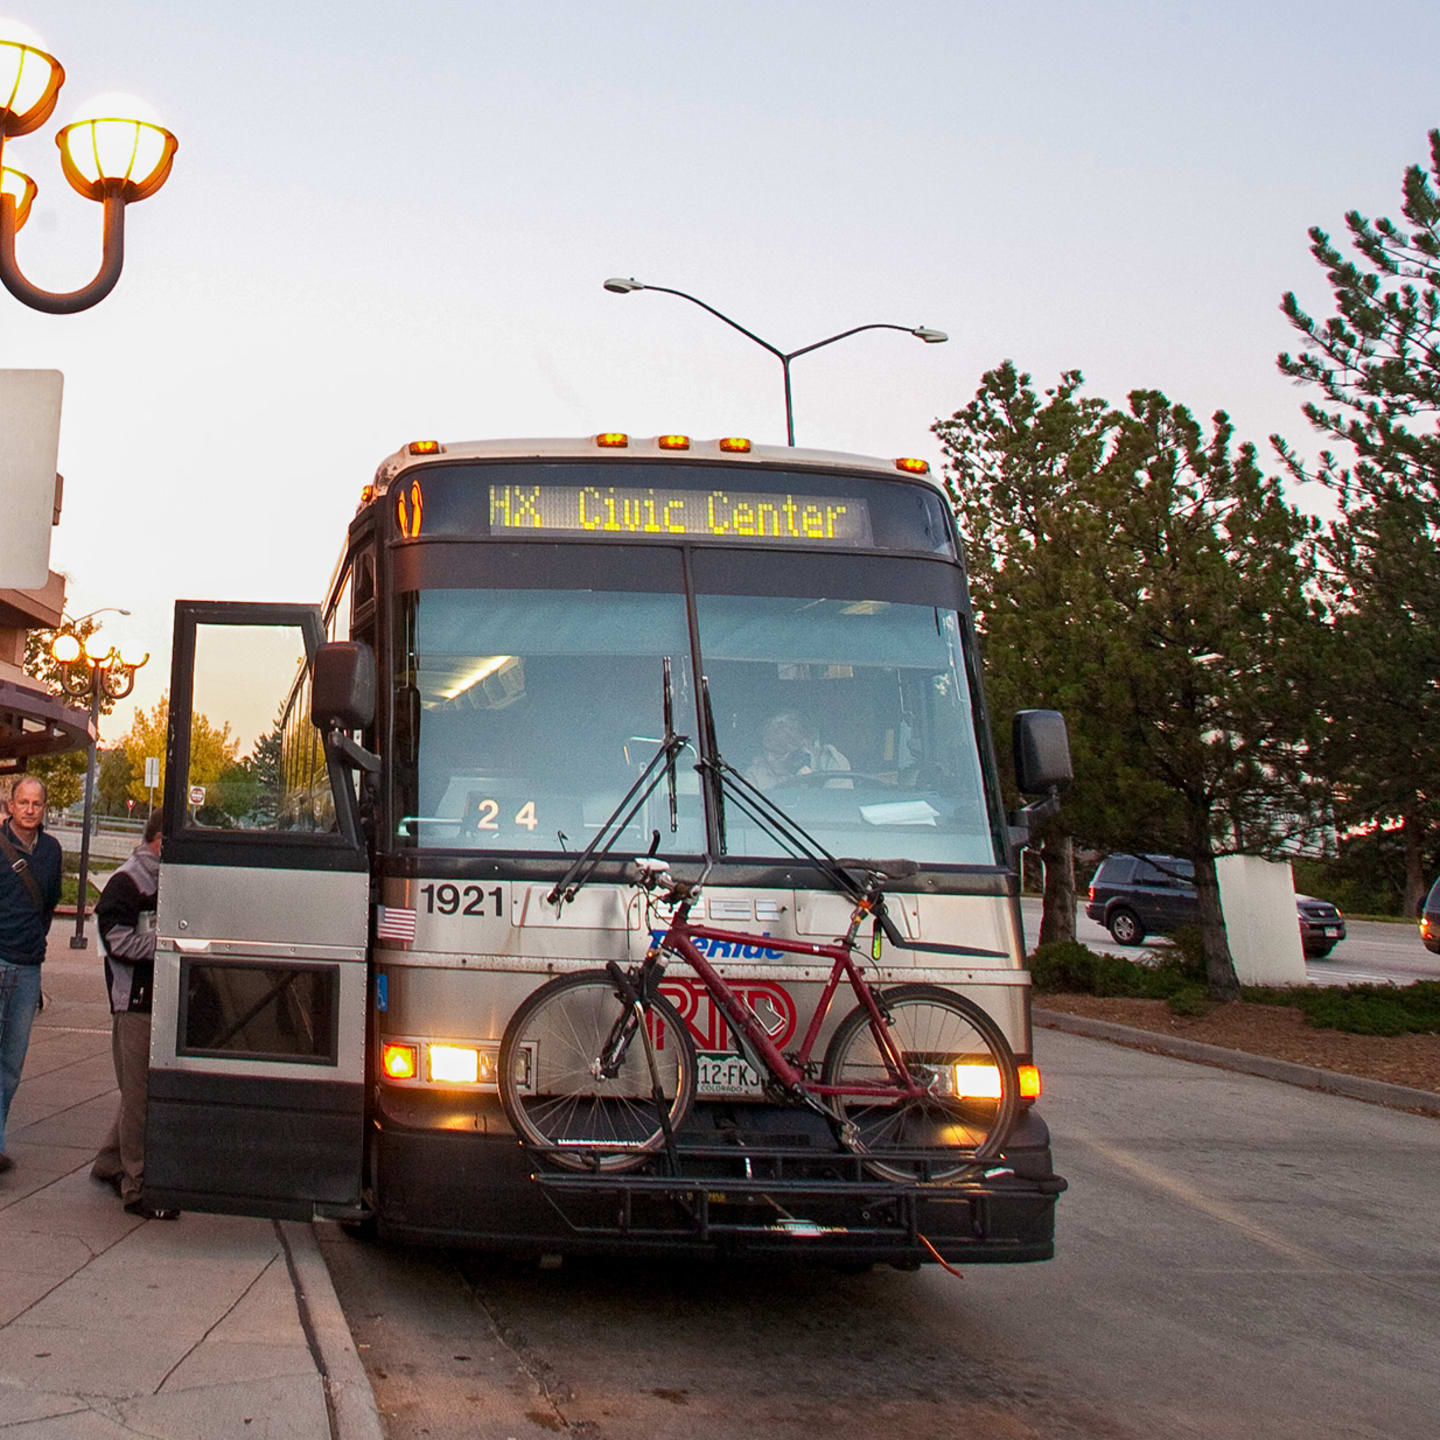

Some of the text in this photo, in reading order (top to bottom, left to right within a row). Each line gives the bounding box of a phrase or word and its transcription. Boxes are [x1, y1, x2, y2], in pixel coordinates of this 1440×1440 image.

[490, 485, 847, 538] HX Civic Center
[421, 883, 502, 917] 1921
[700, 1085, 744, 1093] COLORADO
